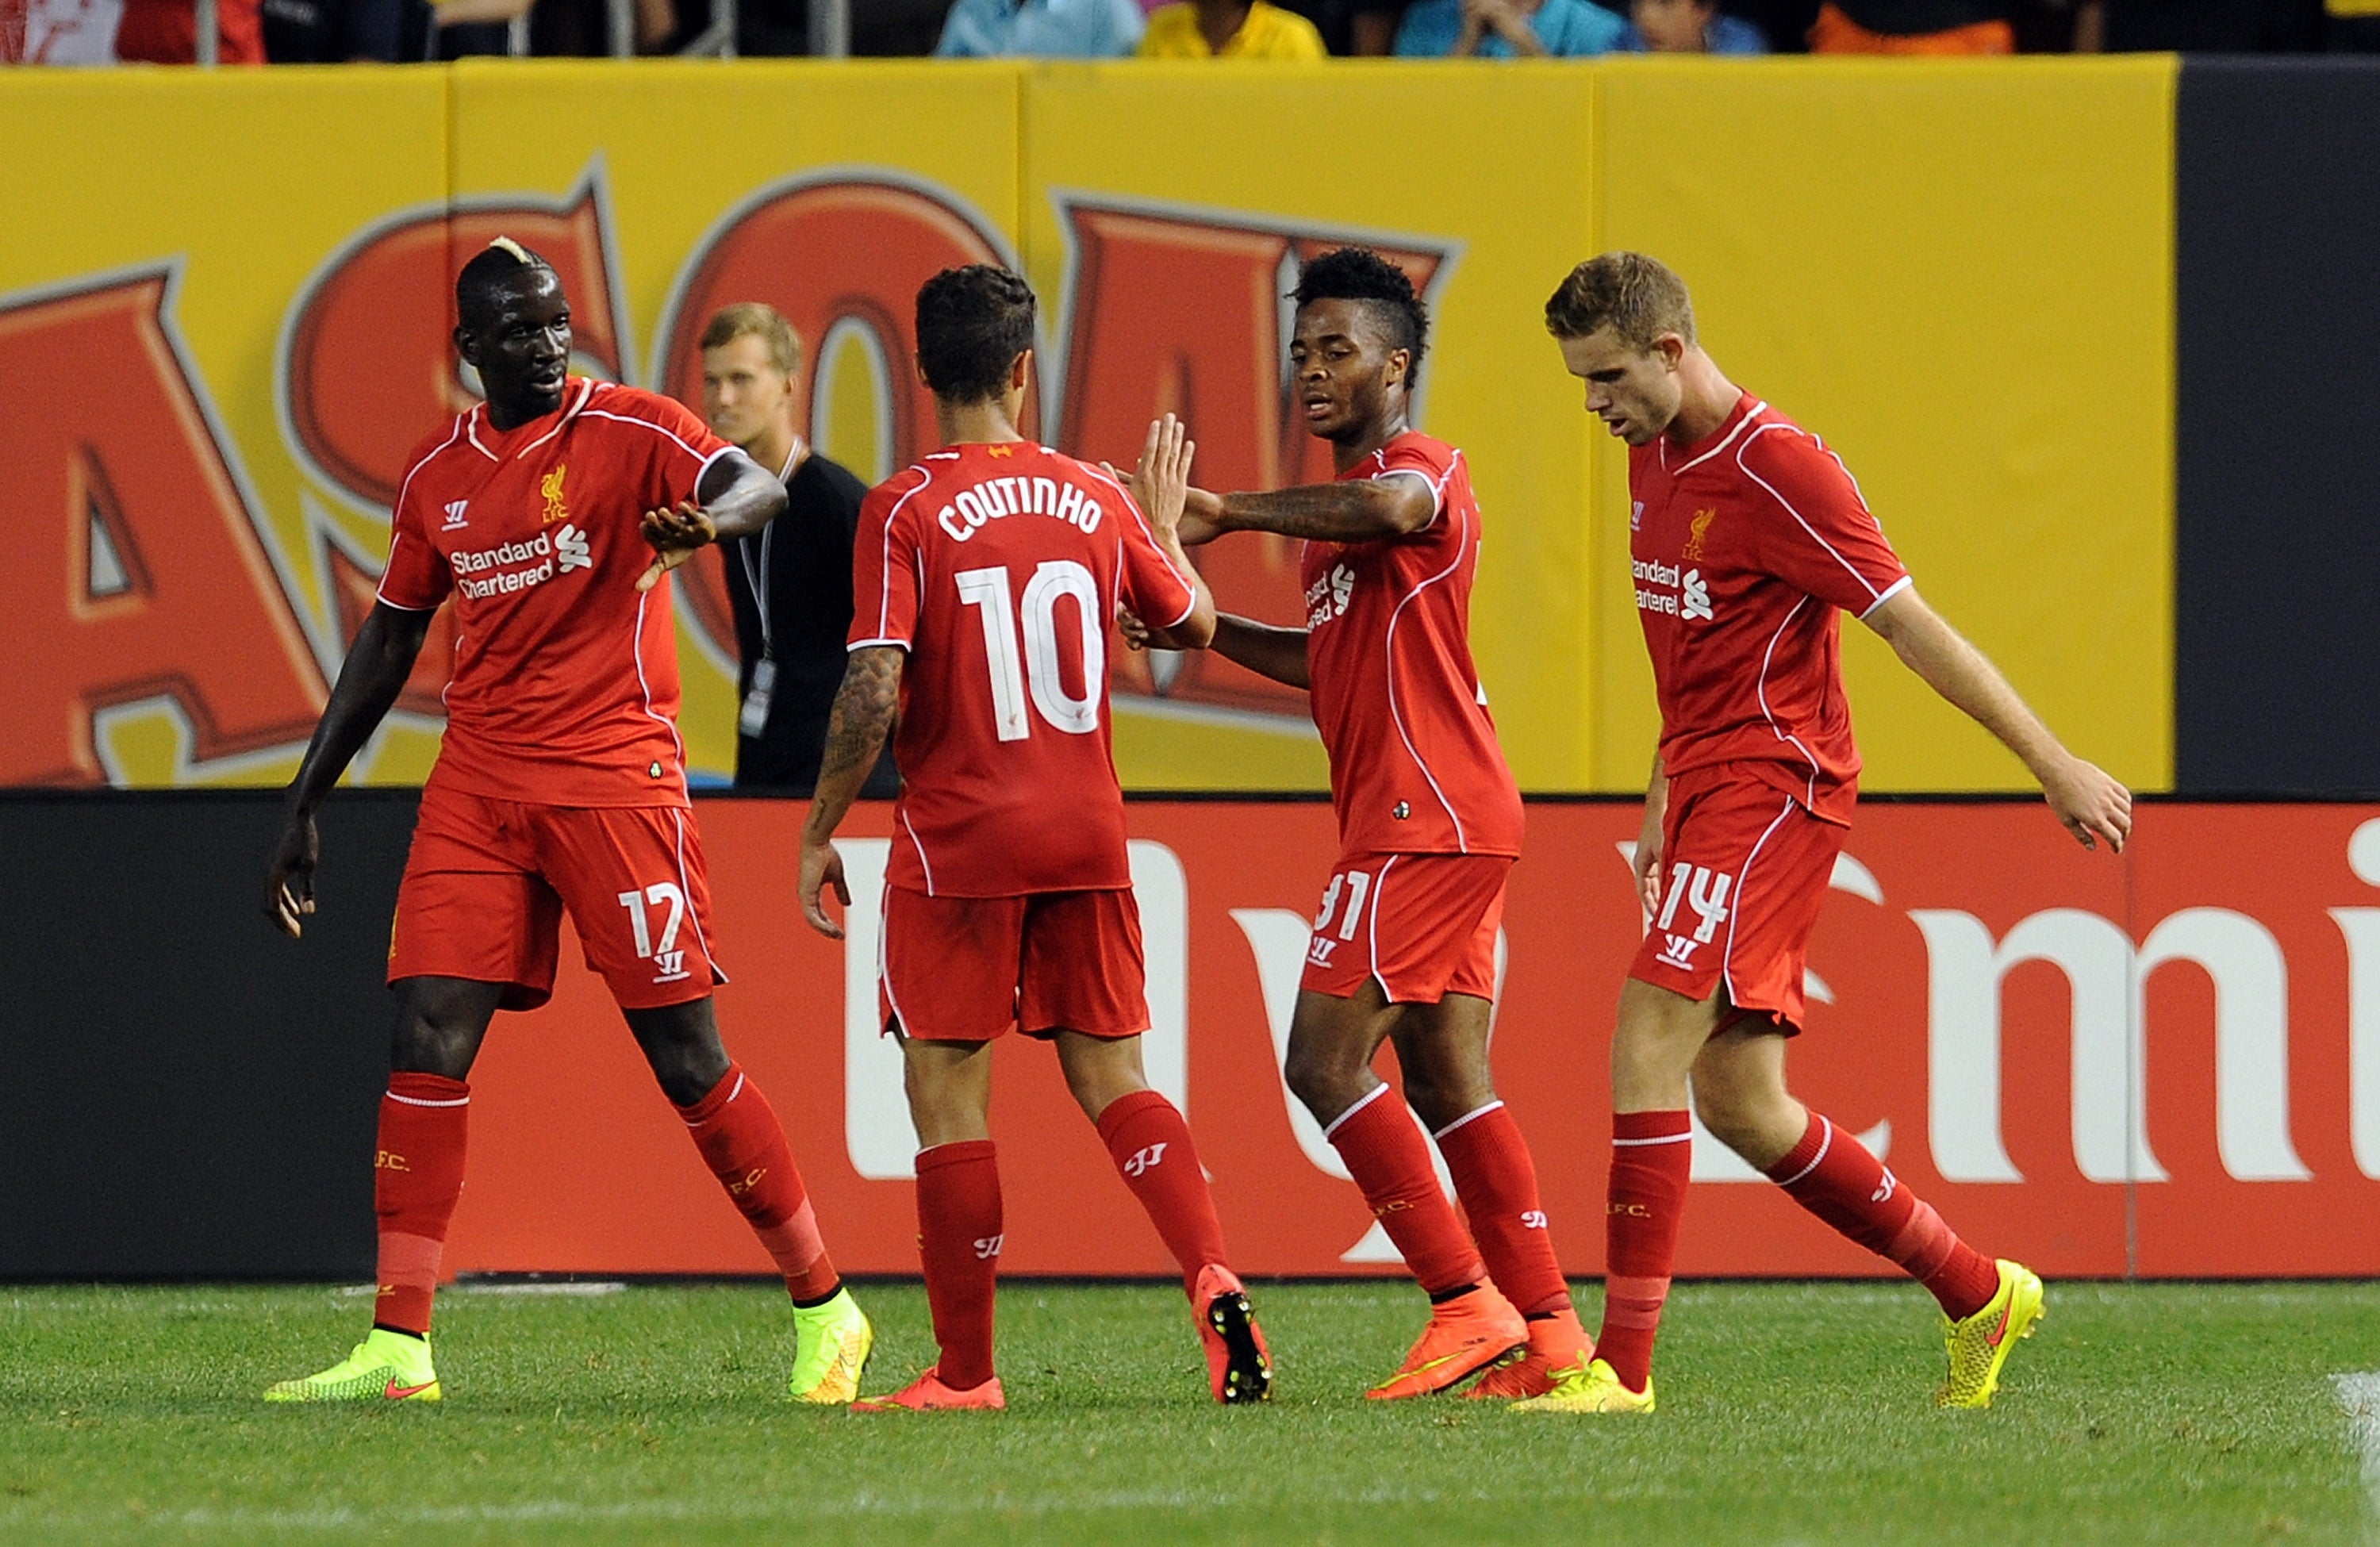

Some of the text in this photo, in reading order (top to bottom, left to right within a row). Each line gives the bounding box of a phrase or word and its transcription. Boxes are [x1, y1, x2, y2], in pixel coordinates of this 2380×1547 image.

[542, 505, 568, 524] LFC
[938, 476, 1103, 543] COUTINHO
[450, 532, 551, 575] Standard
[458, 559, 553, 600] Chartered
[954, 559, 1105, 743] 10
[1656, 862, 1733, 945] 14
